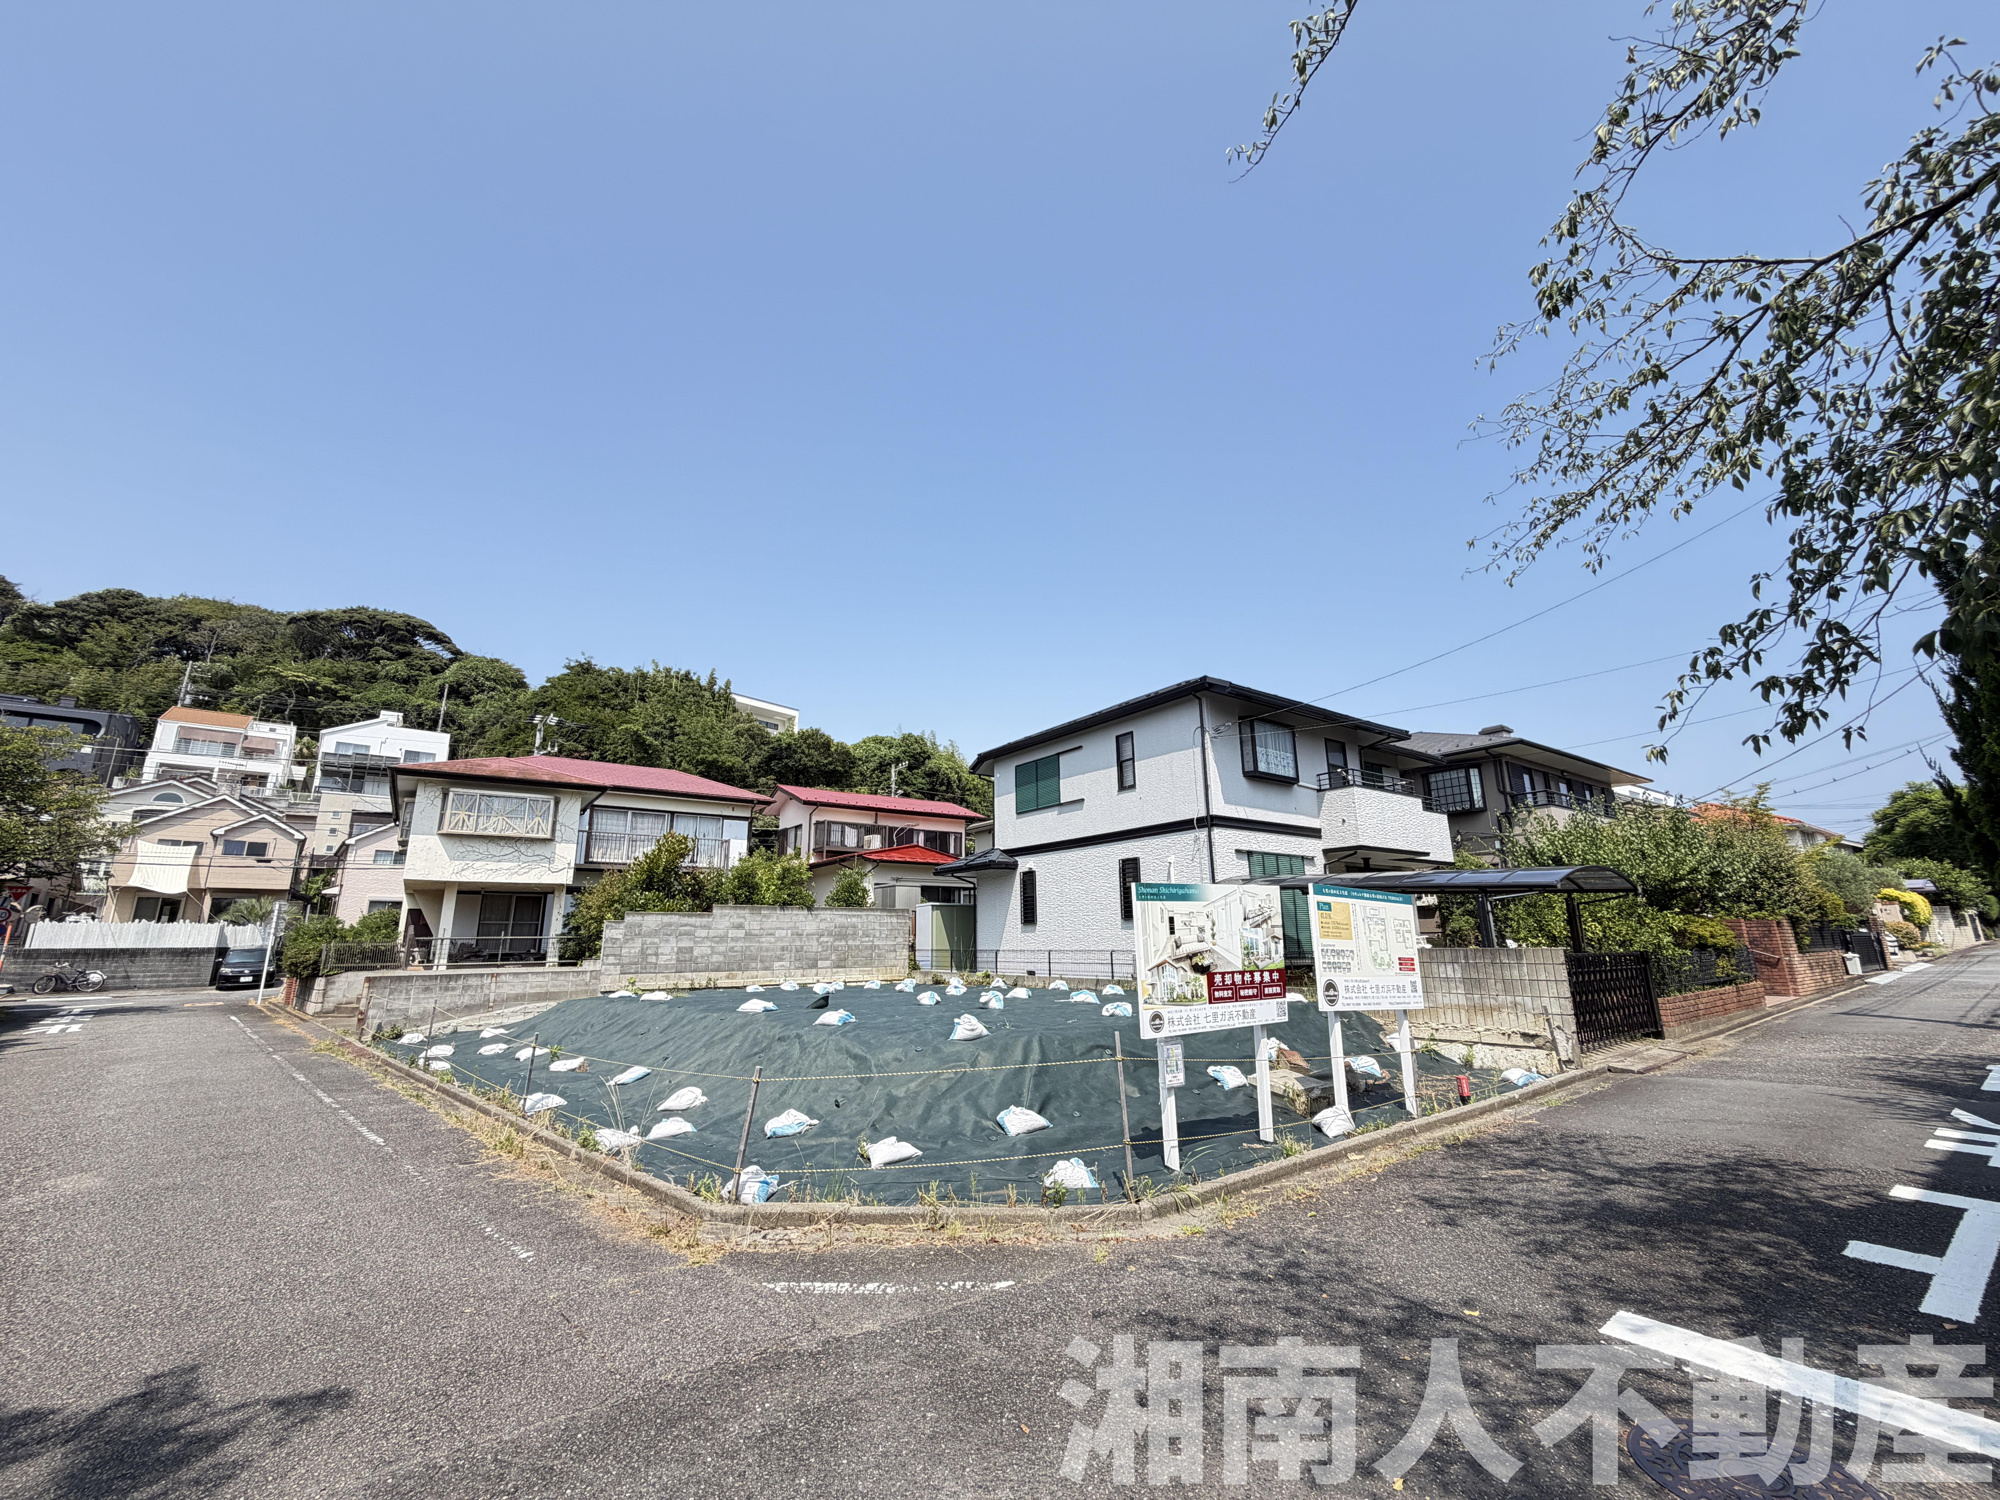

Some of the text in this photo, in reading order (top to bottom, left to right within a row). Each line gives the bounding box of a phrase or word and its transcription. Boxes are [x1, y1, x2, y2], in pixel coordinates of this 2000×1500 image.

[1214, 971, 1279, 986] 売却物件募集中
[1344, 984, 1368, 994] 株式会社
[1167, 1012, 1201, 1029] 株式会社
[1203, 1008, 1257, 1024] 七里ガ浜不動産
